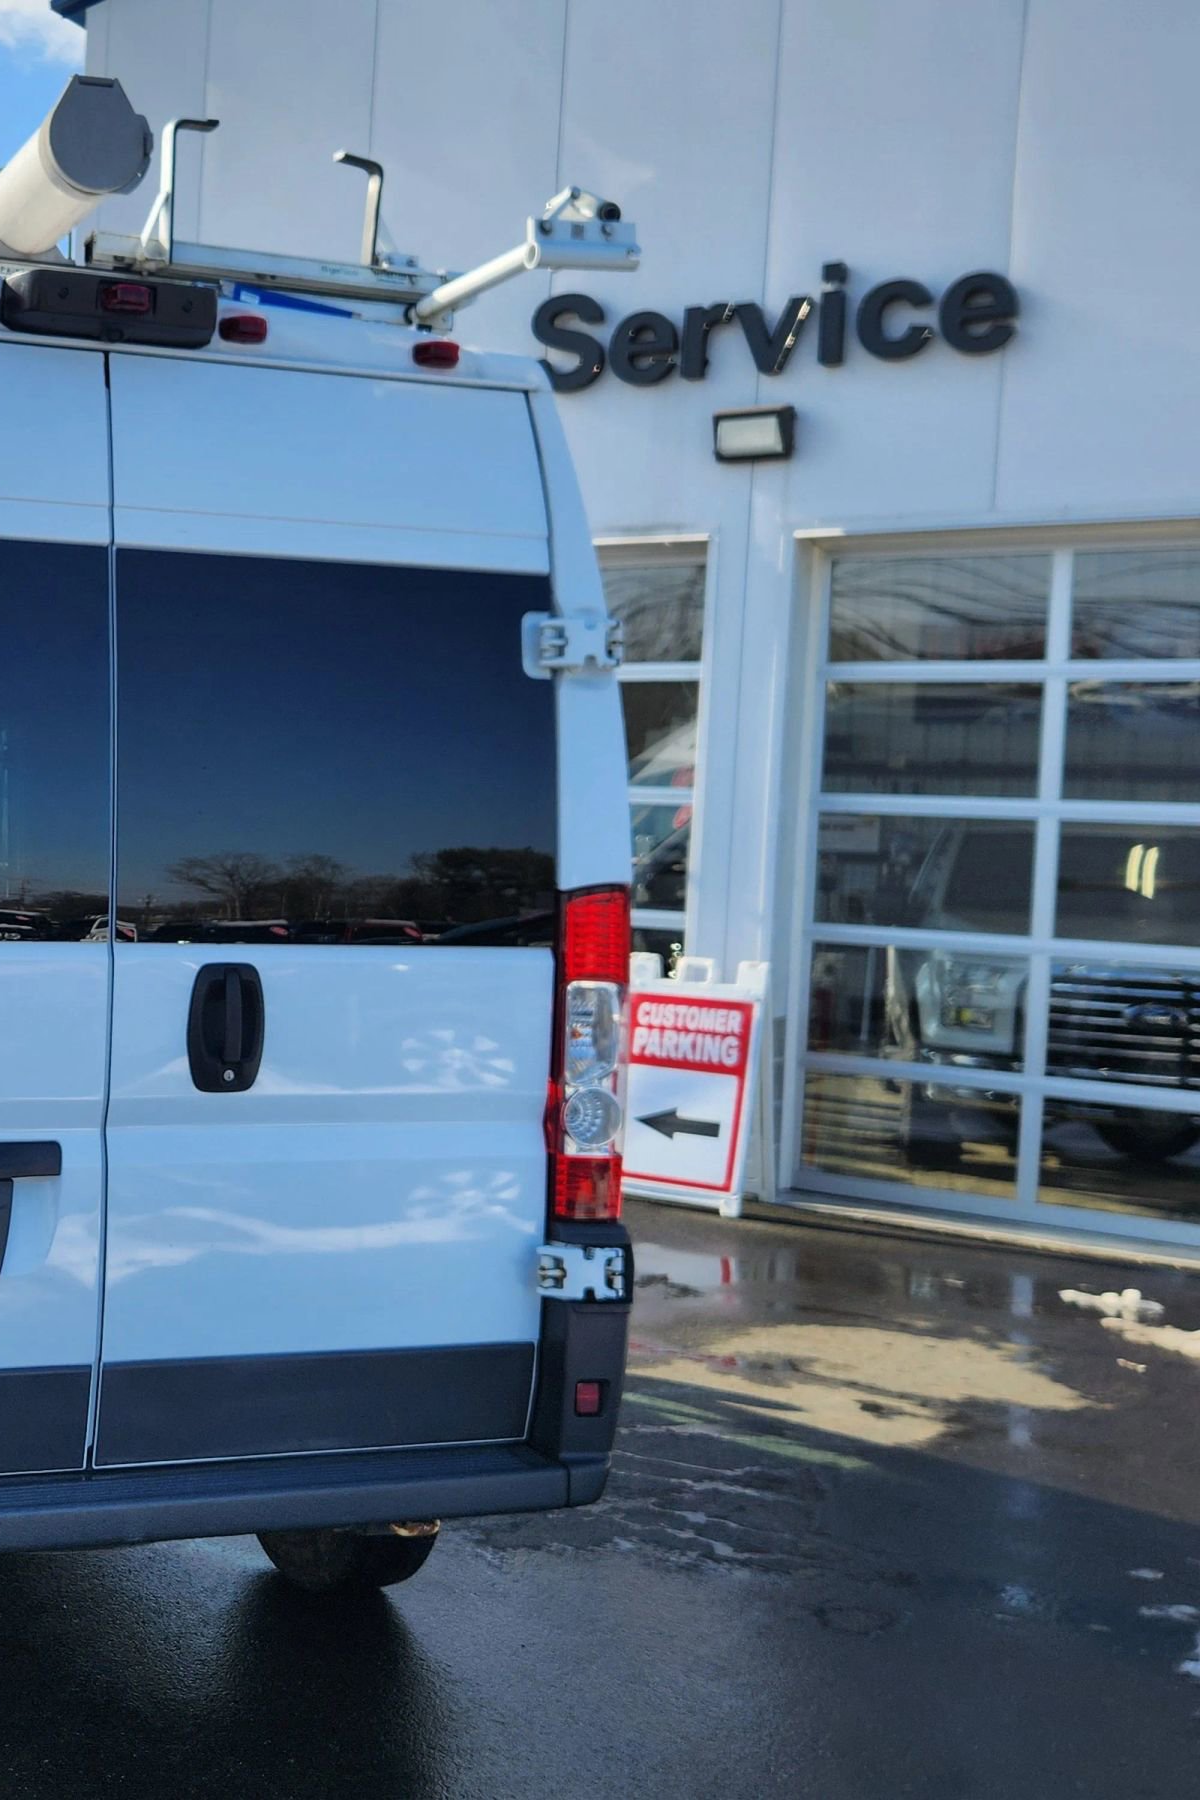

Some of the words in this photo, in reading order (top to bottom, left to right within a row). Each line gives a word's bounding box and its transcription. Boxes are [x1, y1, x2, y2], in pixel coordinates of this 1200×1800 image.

[532, 261, 1019, 393] Service
[637, 1001, 743, 1034] CUSTOMER
[632, 1026, 740, 1067] PARKING
